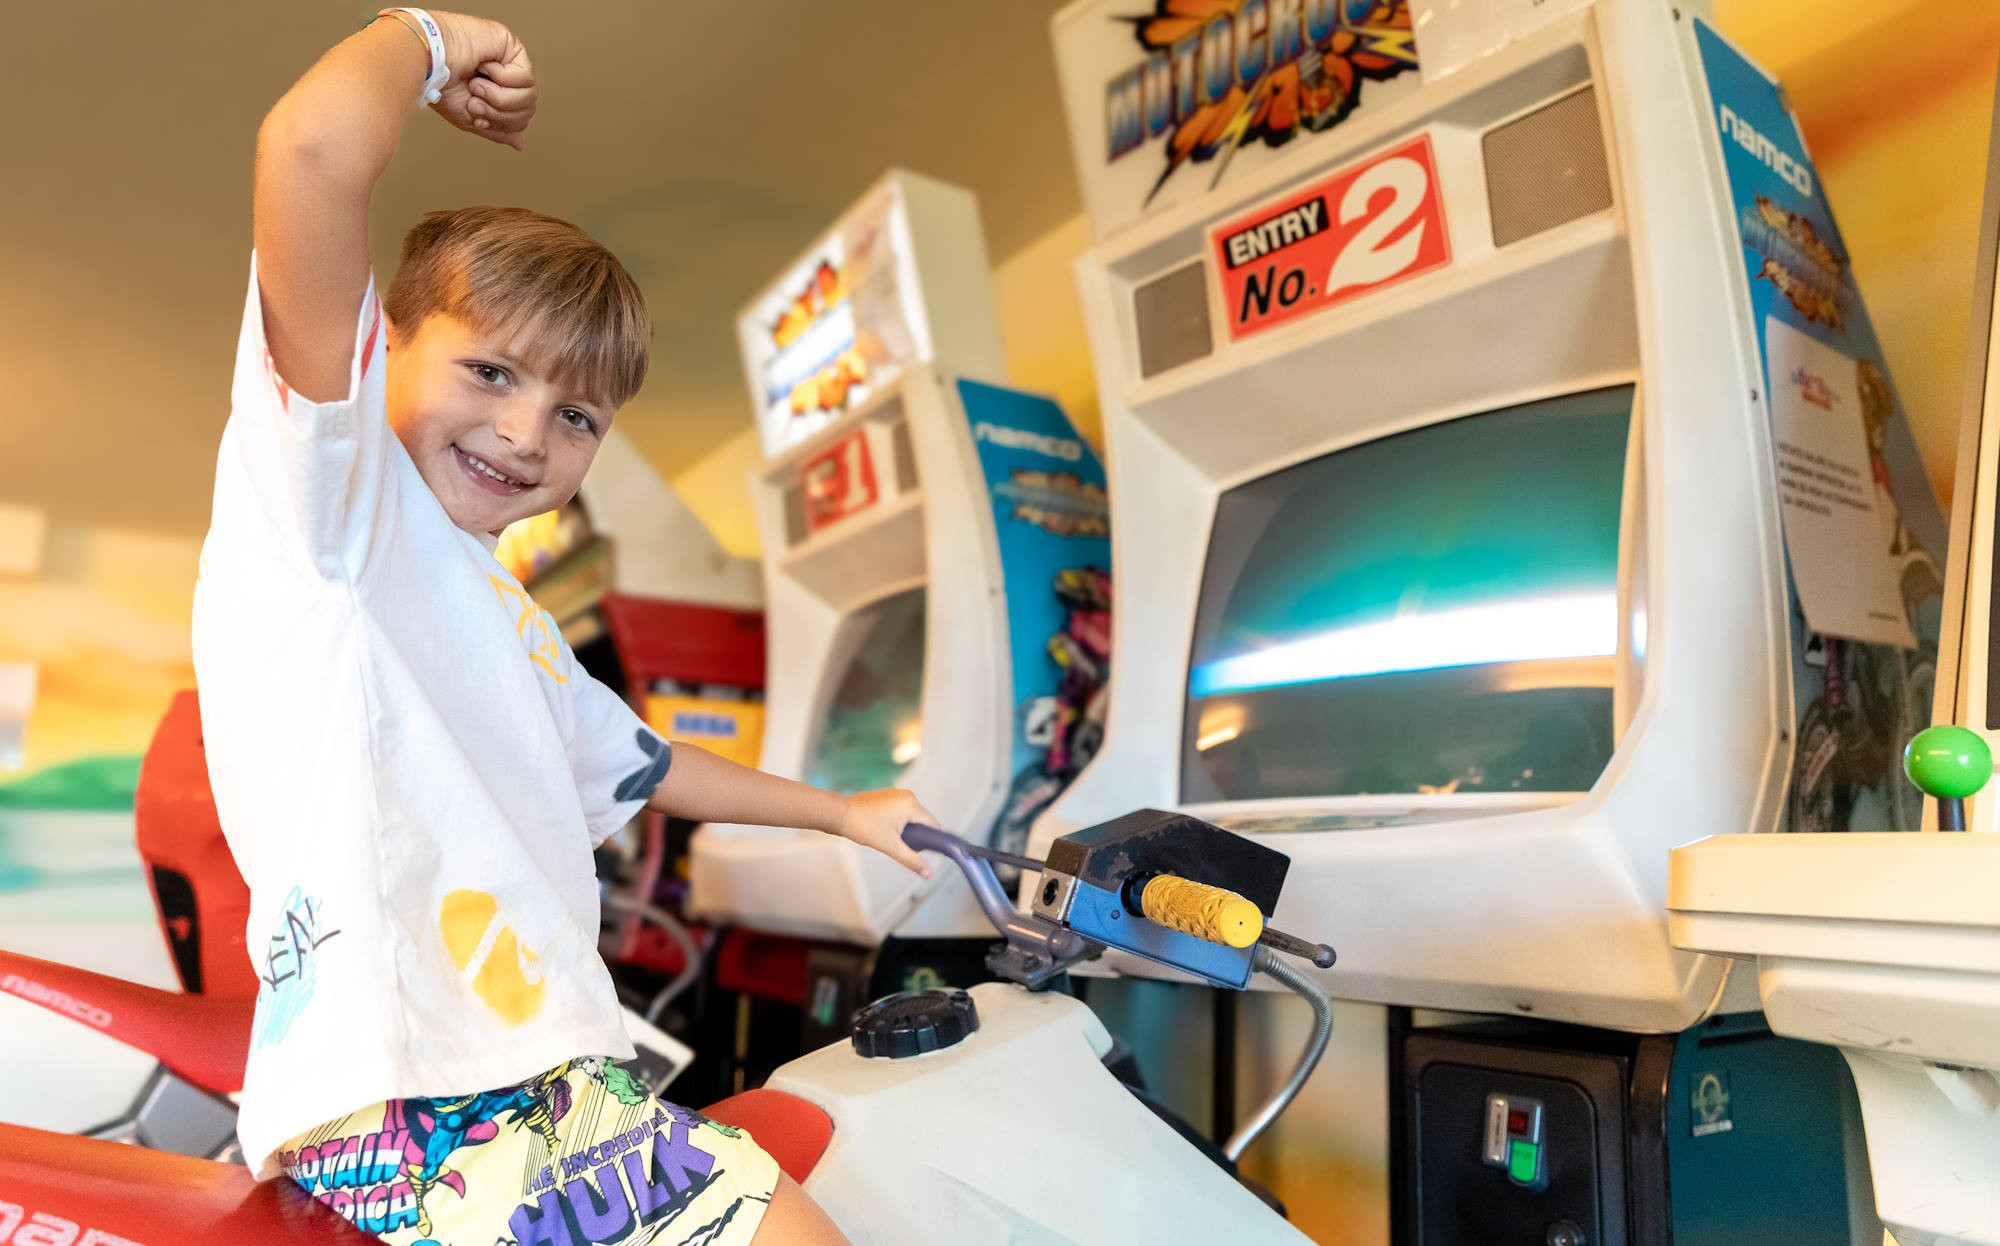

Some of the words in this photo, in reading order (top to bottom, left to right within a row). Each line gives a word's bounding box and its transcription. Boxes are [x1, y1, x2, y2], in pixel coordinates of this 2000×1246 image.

[1720, 103, 1812, 198] namco
[1229, 202, 1323, 265] ENTRY
[1240, 265, 1316, 323] No.
[1326, 156, 1428, 297] 2
[975, 421, 1083, 462] namco
[509, 1121, 716, 1246] HULK
